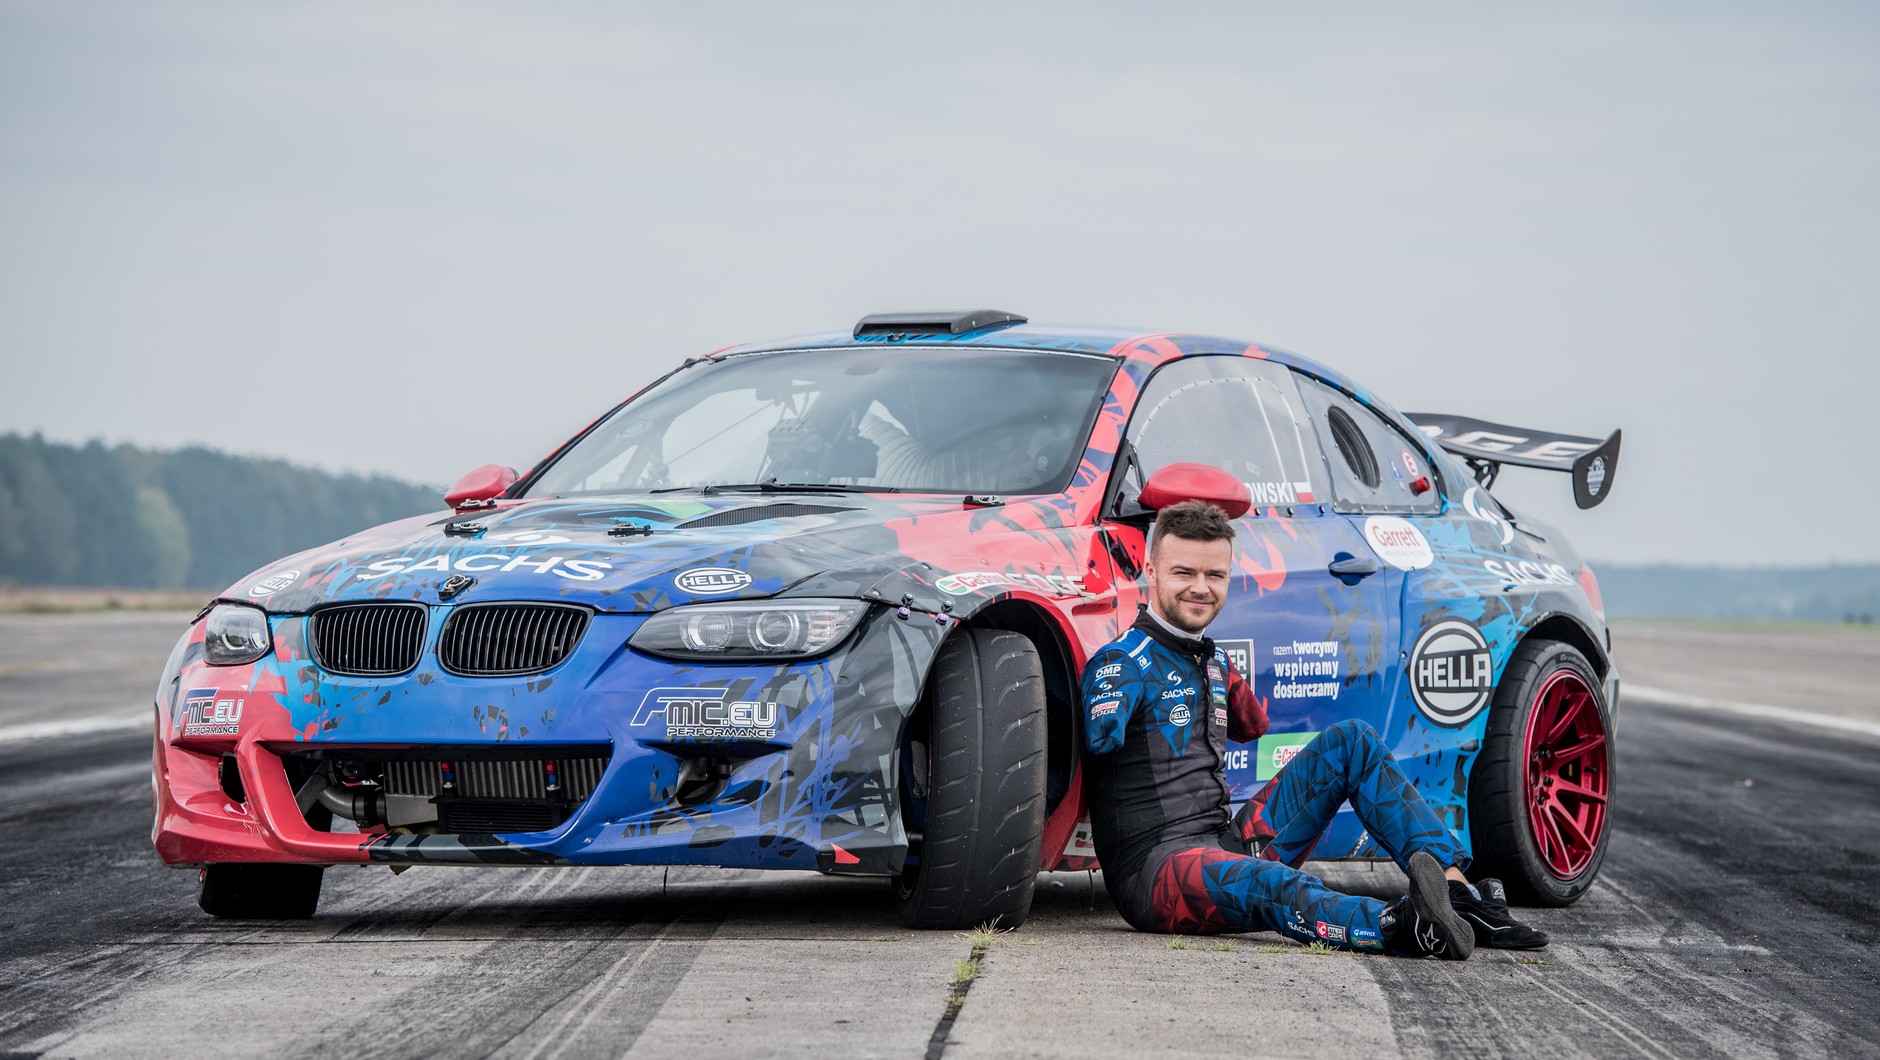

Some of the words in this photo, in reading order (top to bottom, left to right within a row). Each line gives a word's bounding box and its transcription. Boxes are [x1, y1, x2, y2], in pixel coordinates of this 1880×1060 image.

[1372, 525, 1421, 547] Garrett
[357, 554, 613, 581] SACHS
[1483, 560, 1576, 585] SACHS
[682, 574, 752, 586] HELLA
[1005, 573, 1096, 600] EDGE
[1273, 646, 1293, 655] razem
[1293, 640, 1338, 657] tworzymy
[1095, 665, 1121, 678] OMP
[1274, 656, 1339, 681] wspieramy
[1419, 653, 1491, 687] HELLA
[1091, 691, 1123, 704] SACHS
[1161, 687, 1195, 700] SACHS
[1273, 680, 1340, 700] dostarczamy
[1091, 709, 1117, 720] EDGE
[185, 725, 239, 736] PERFORMANCE
[667, 726, 776, 738] PERFORMANCE
[1288, 921, 1316, 938] SACHS
